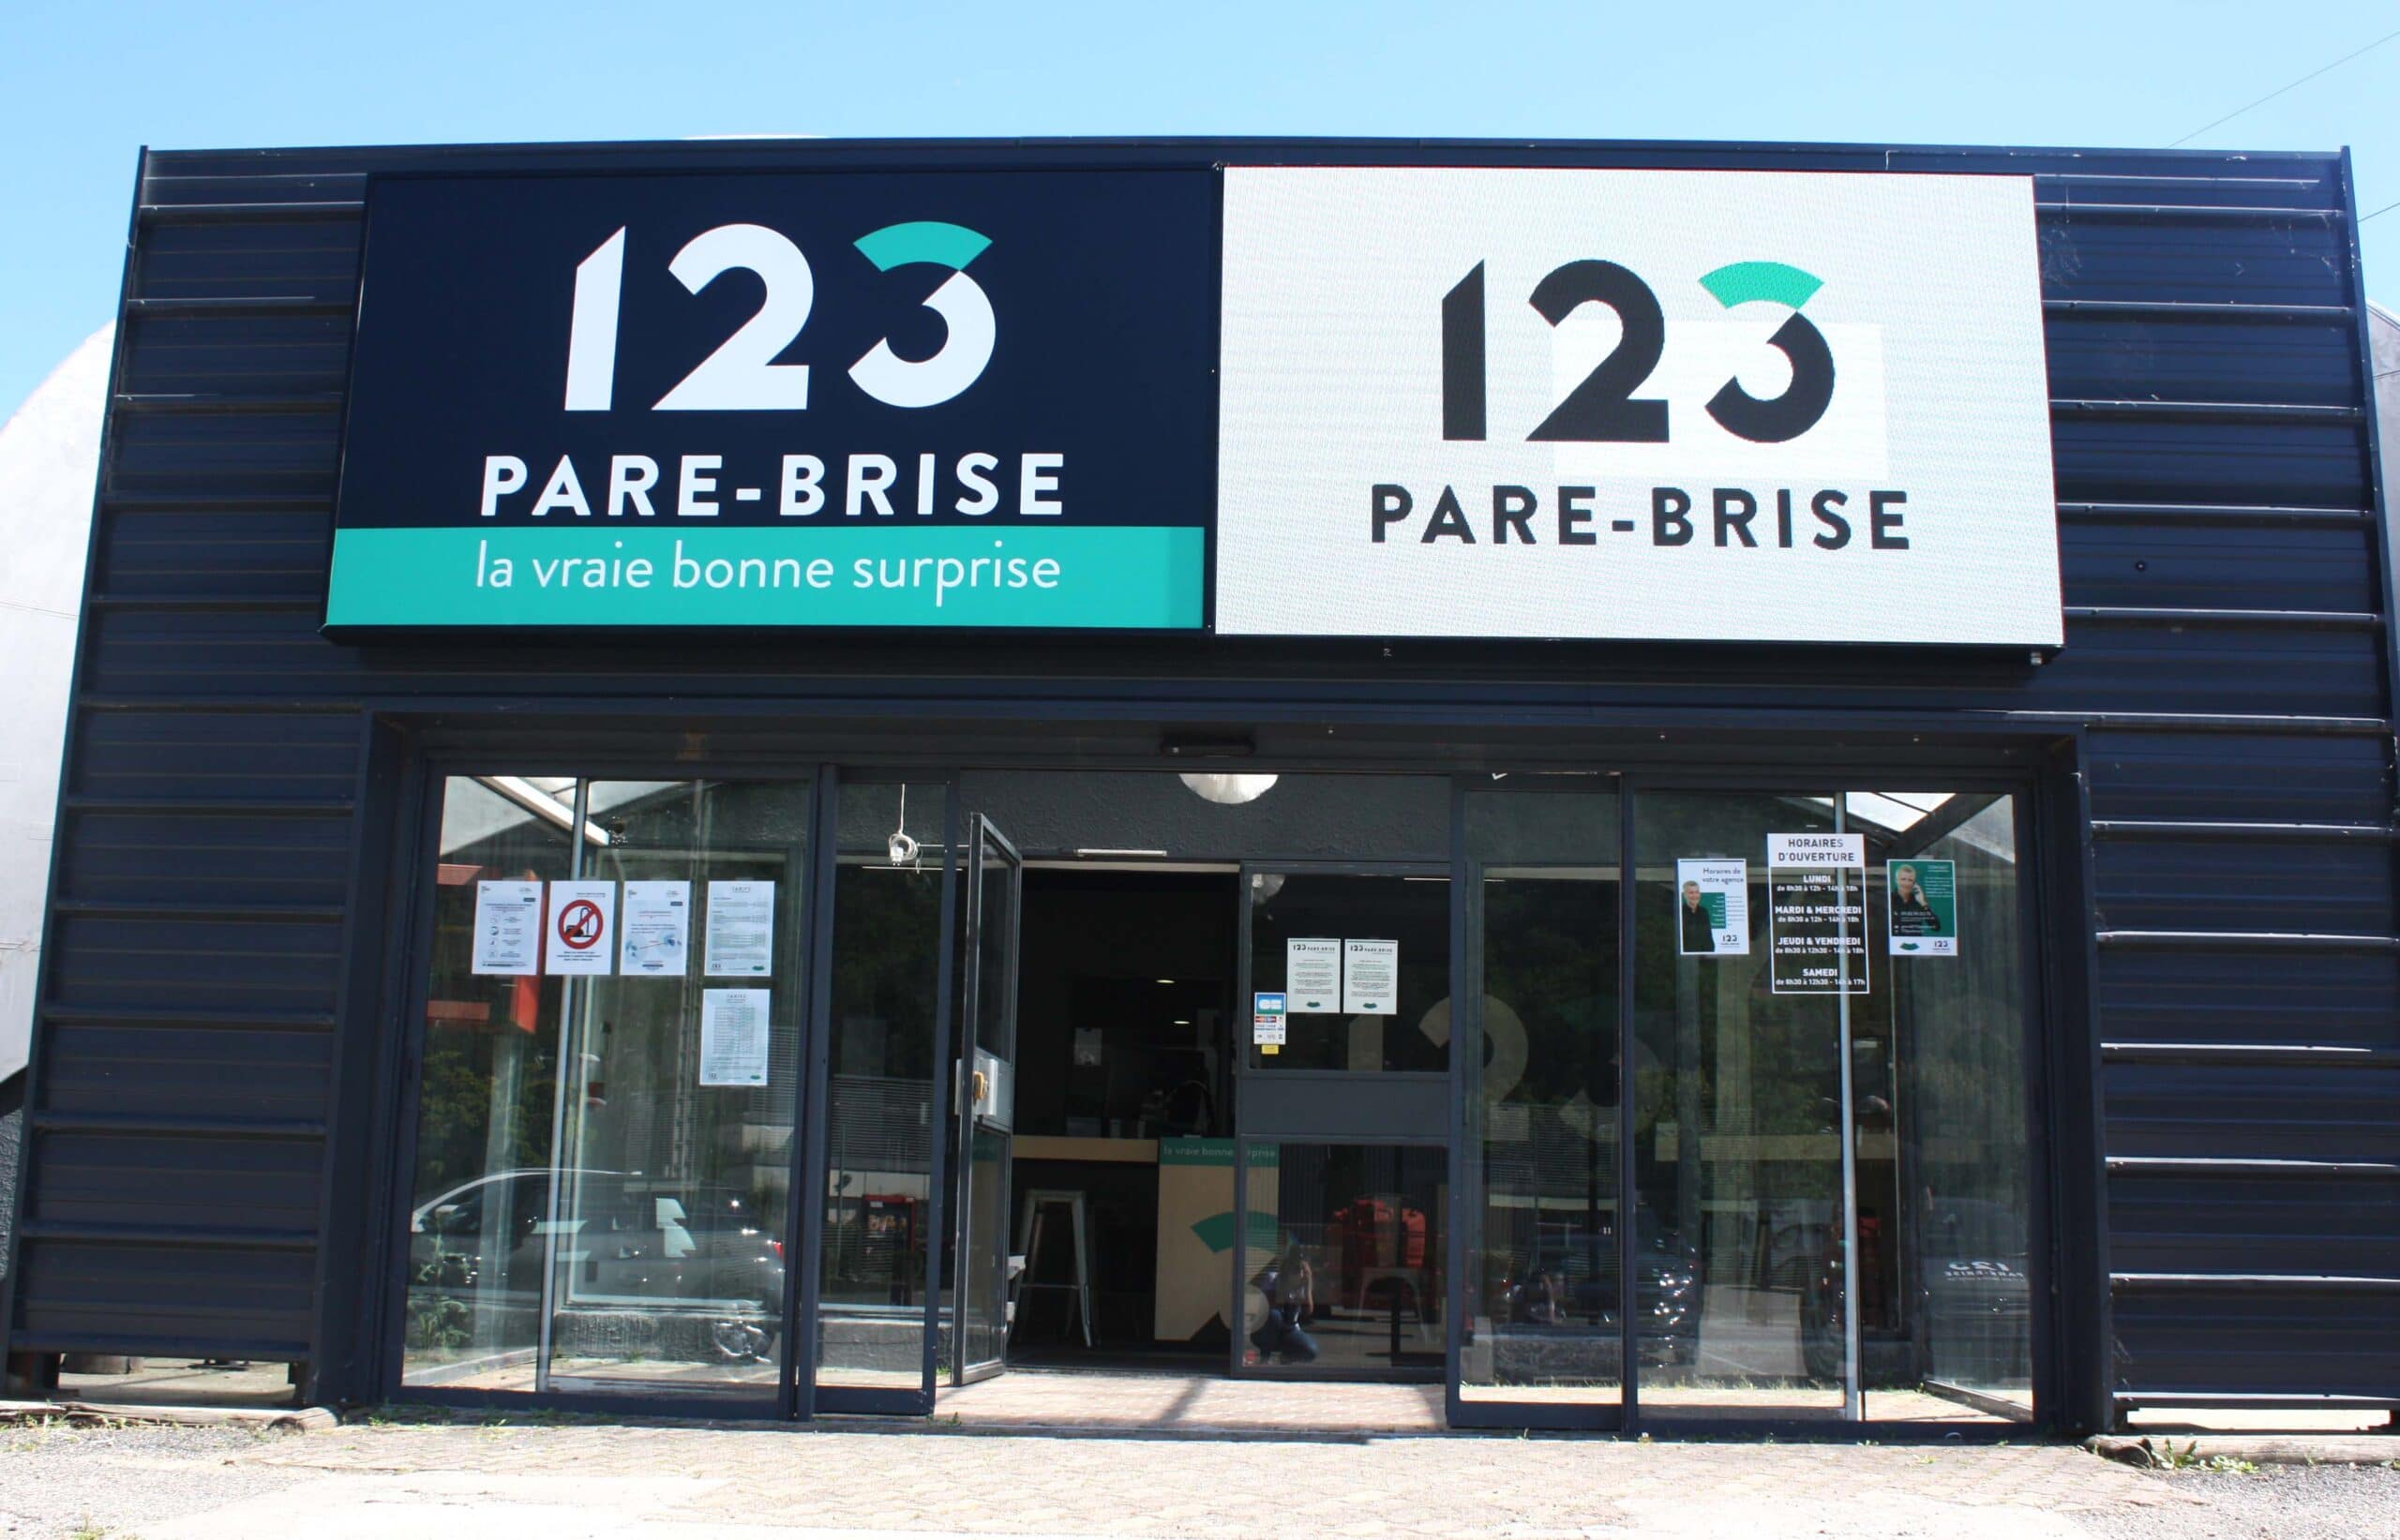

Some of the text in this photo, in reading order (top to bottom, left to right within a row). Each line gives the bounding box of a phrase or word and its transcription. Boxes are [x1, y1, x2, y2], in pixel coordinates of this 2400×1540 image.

[564, 221, 997, 411] 123
[1441, 258, 1836, 443] 123
[480, 452, 1064, 517] PARE-BRISE
[1371, 484, 1911, 550] PARE-BRISE
[476, 539, 1061, 607] la vraie bonne surprise
[1788, 839, 1844, 848] HORAIRES
[1778, 852, 1855, 861] D'OUVERTURE
[1803, 875, 1831, 883] LUNDI
[1775, 905, 1862, 914] MARDI & MERCREDI
[1778, 936, 1861, 945] JEUDI & VENDREDI
[1803, 968, 1838, 977] SAMEDI
